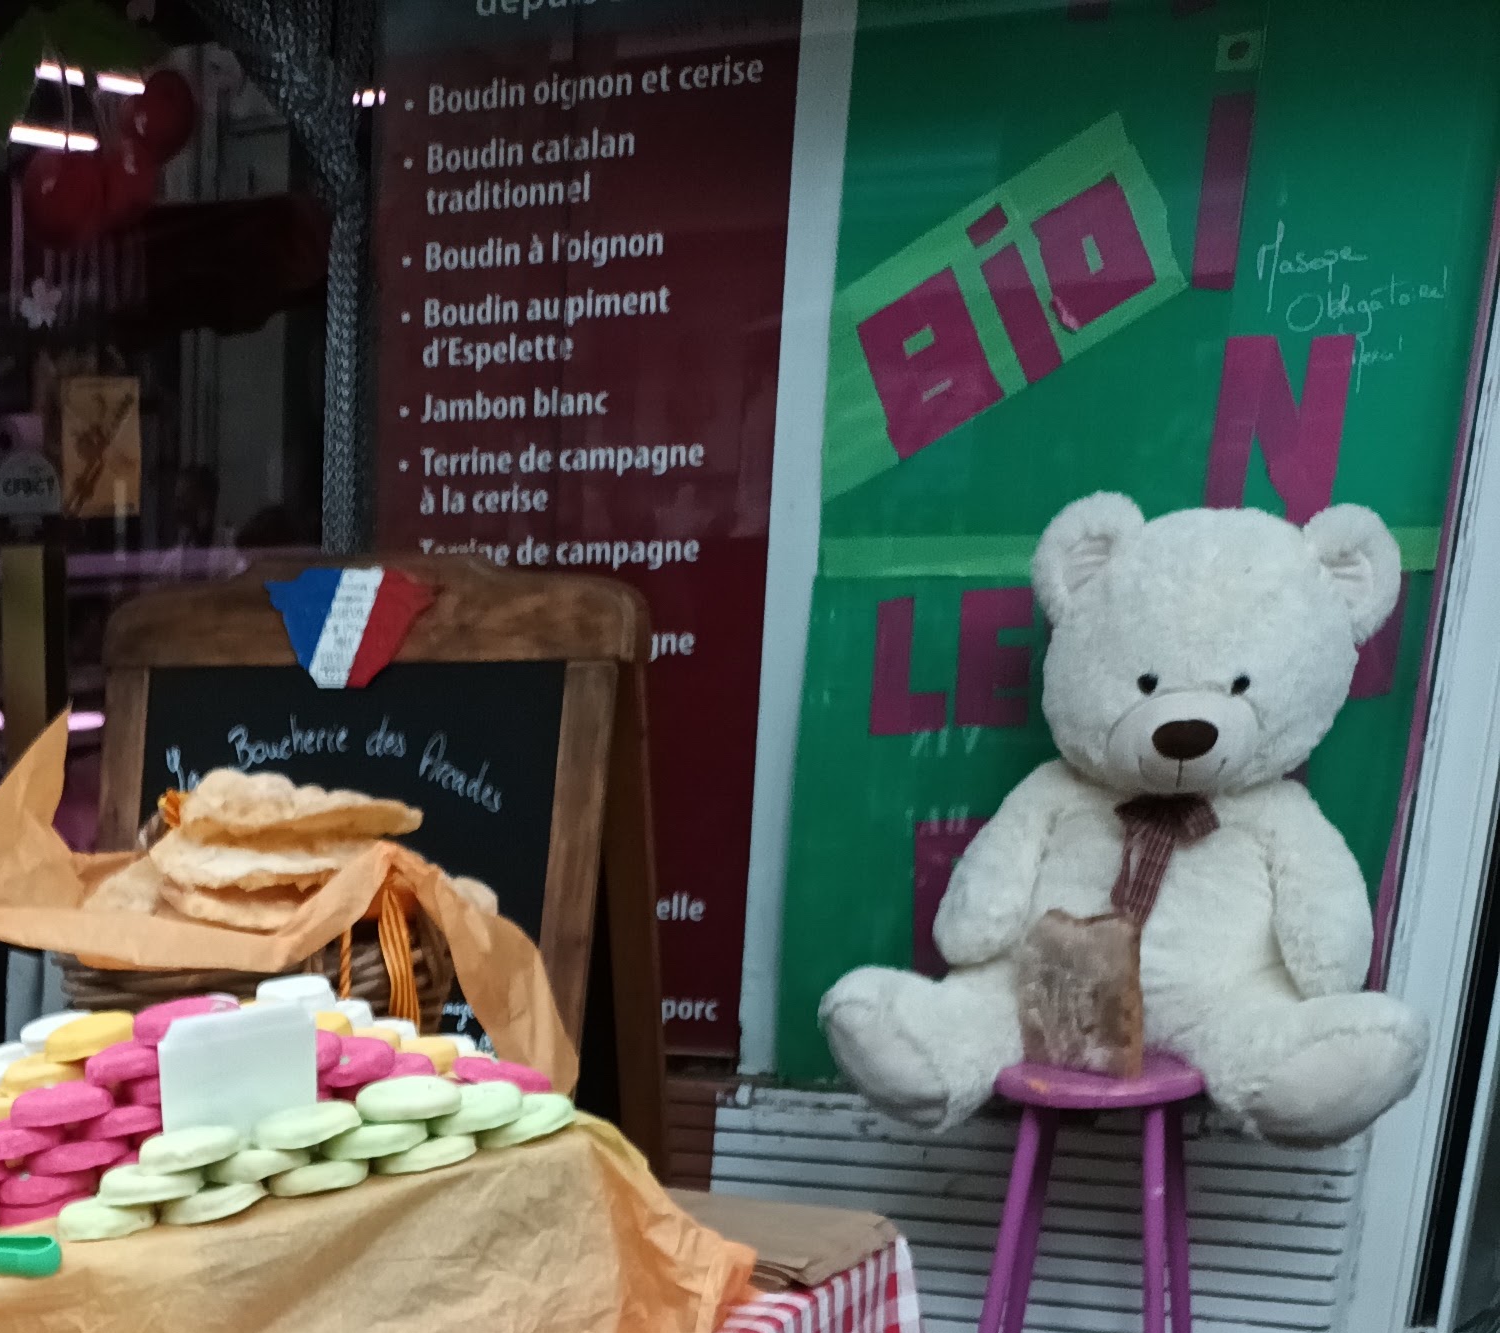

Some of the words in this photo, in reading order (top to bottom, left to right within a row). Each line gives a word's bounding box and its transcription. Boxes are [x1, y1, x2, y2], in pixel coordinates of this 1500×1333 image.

[427, 77, 525, 115] Boudin
[533, 72, 633, 110] oignon
[641, 64, 671, 94] et
[678, 54, 765, 90] cerise
[426, 137, 524, 175] Boudin
[531, 127, 635, 165] catalan
[426, 171, 591, 216] traditionnel
[425, 236, 521, 273] Boudin
[528, 233, 544, 265] à
[552, 230, 664, 268] l'oignon
[424, 293, 518, 330] Boudin
[526, 298, 559, 322] au
[563, 285, 671, 328] piment
[422, 332, 574, 372] d'Espelette
[420, 389, 526, 423] Jambon
[533, 386, 610, 417] blanc
[420, 446, 512, 477] Terrine
[519, 442, 552, 473] de
[559, 442, 704, 477] campagne
[420, 484, 435, 515] à
[442, 484, 466, 514] la
[472, 482, 548, 514] cerise
[516, 534, 550, 566] de
[555, 538, 700, 572] campagne
[228, 714, 349, 769] Boucherie
[366, 714, 406, 759] des
[661, 998, 720, 1024] porc
